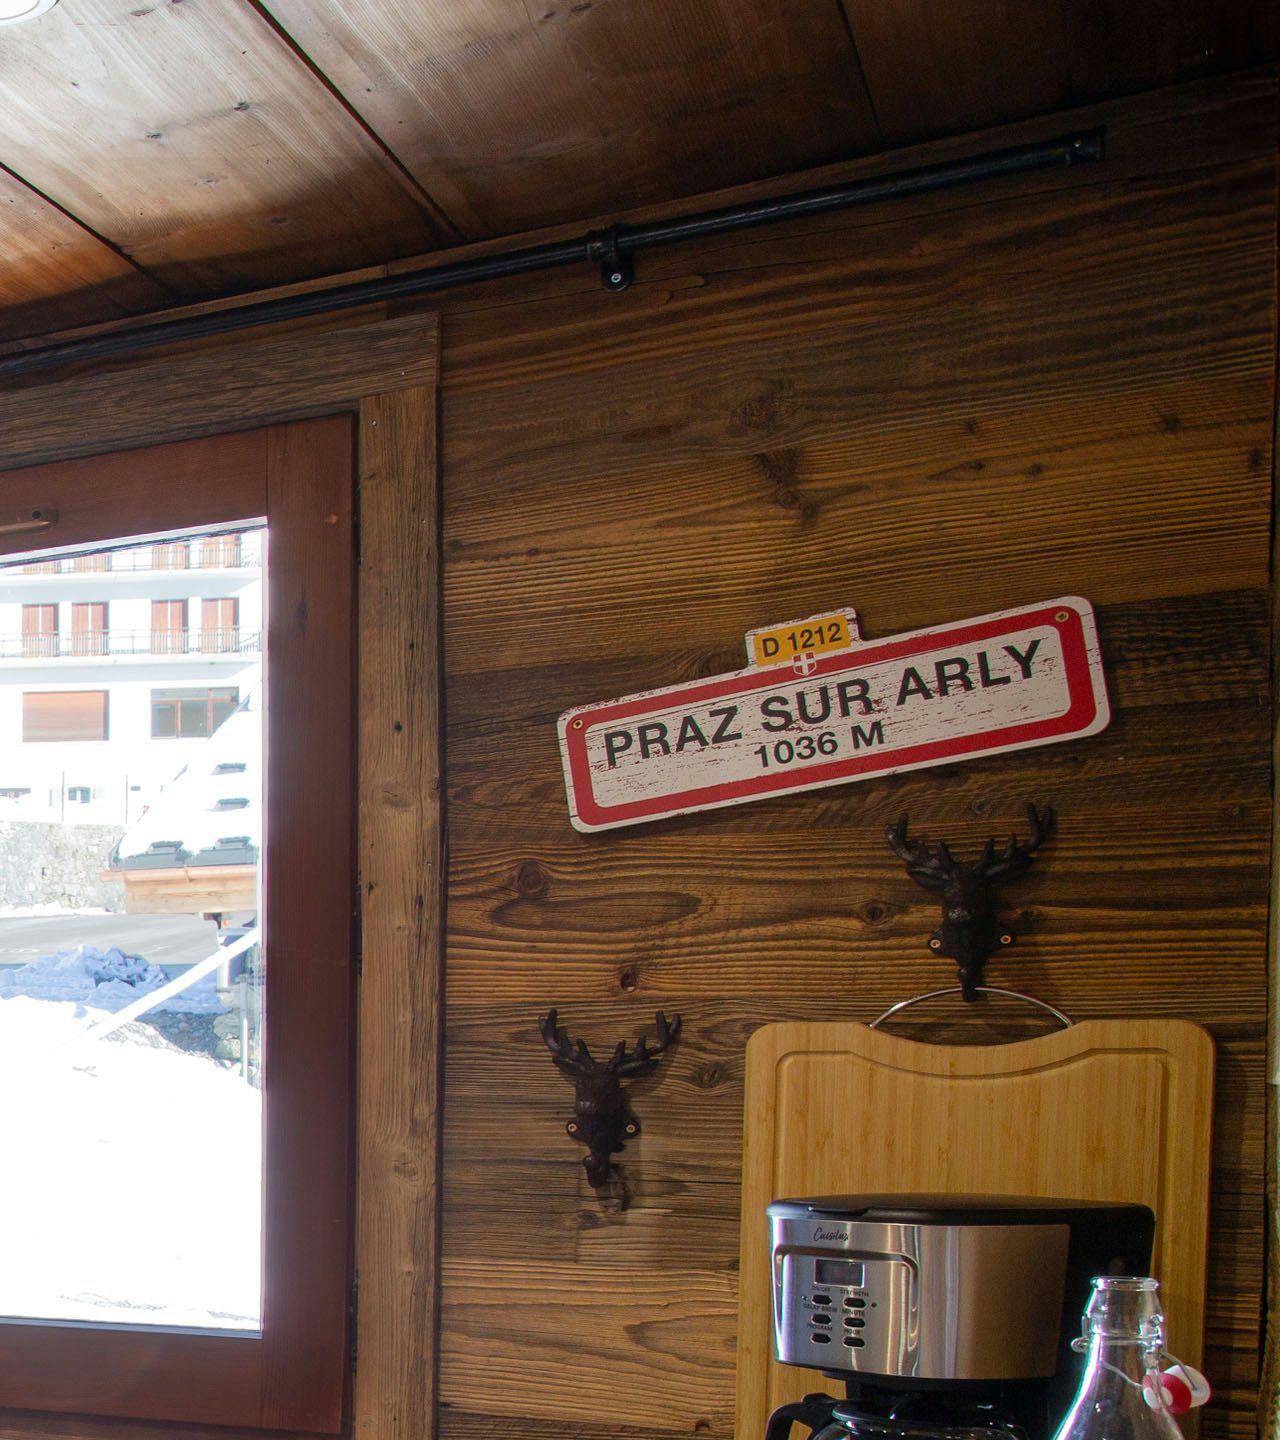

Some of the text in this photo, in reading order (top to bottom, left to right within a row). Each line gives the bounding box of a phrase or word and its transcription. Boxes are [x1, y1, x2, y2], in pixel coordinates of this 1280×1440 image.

[762, 622, 843, 657] D 1212
[604, 639, 1041, 769] PRAZ SUR ARLY
[754, 721, 885, 768] 1036 M
